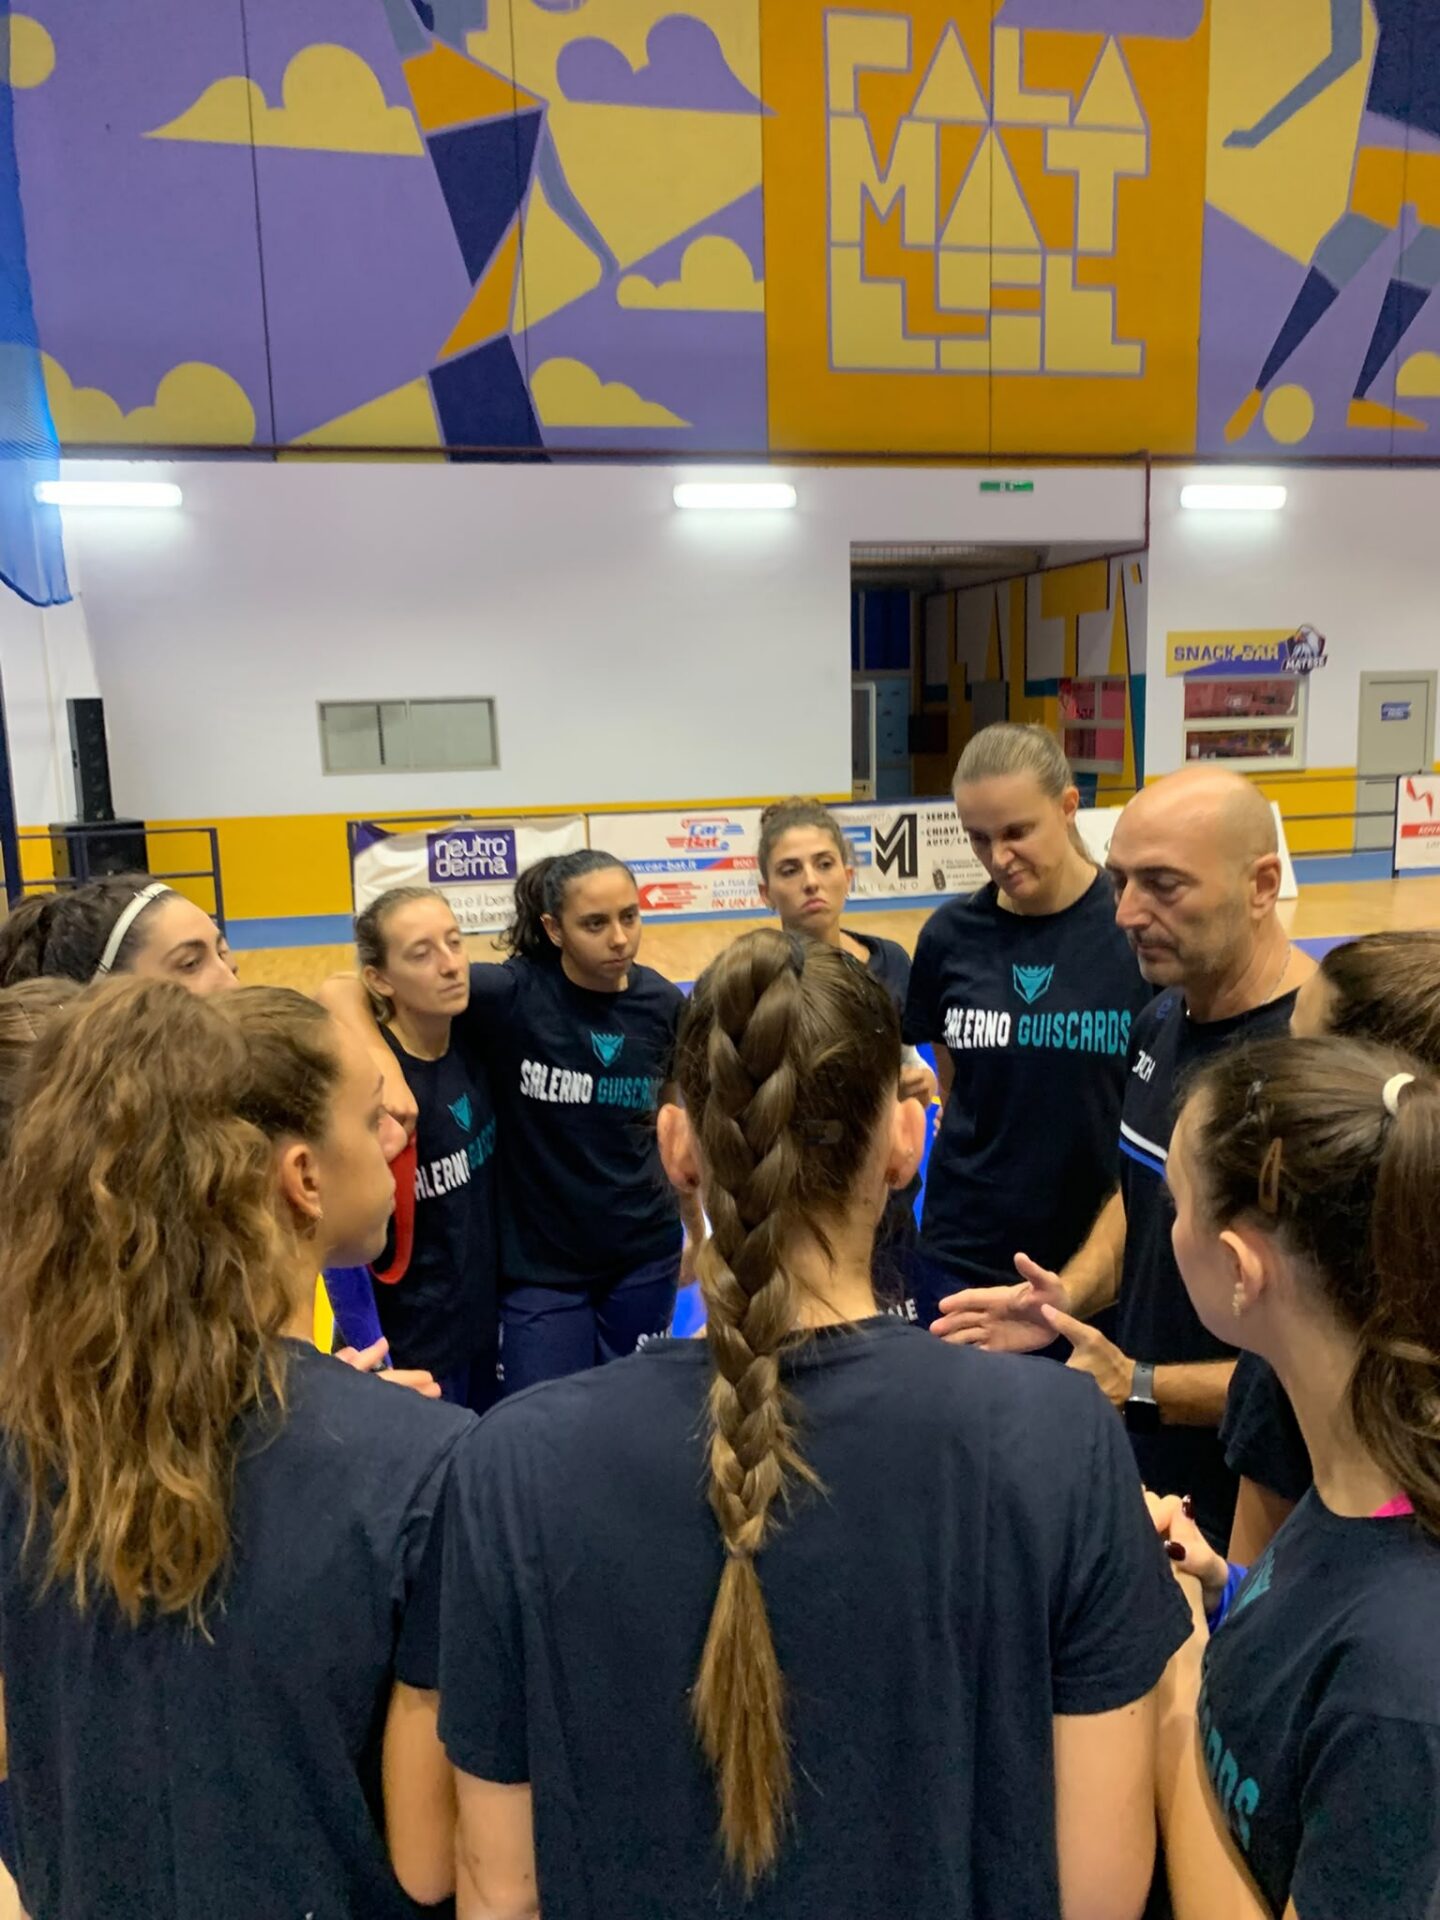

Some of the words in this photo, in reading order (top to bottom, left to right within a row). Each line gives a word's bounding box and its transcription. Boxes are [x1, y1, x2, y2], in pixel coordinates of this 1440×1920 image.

[927, 826, 959, 837] CHIAVI
[434, 835, 507, 860] neutro
[436, 855, 509, 877] derma
[1018, 1010, 1132, 1056] GUISCARDS
[520, 1059, 593, 1104] SALERNO
